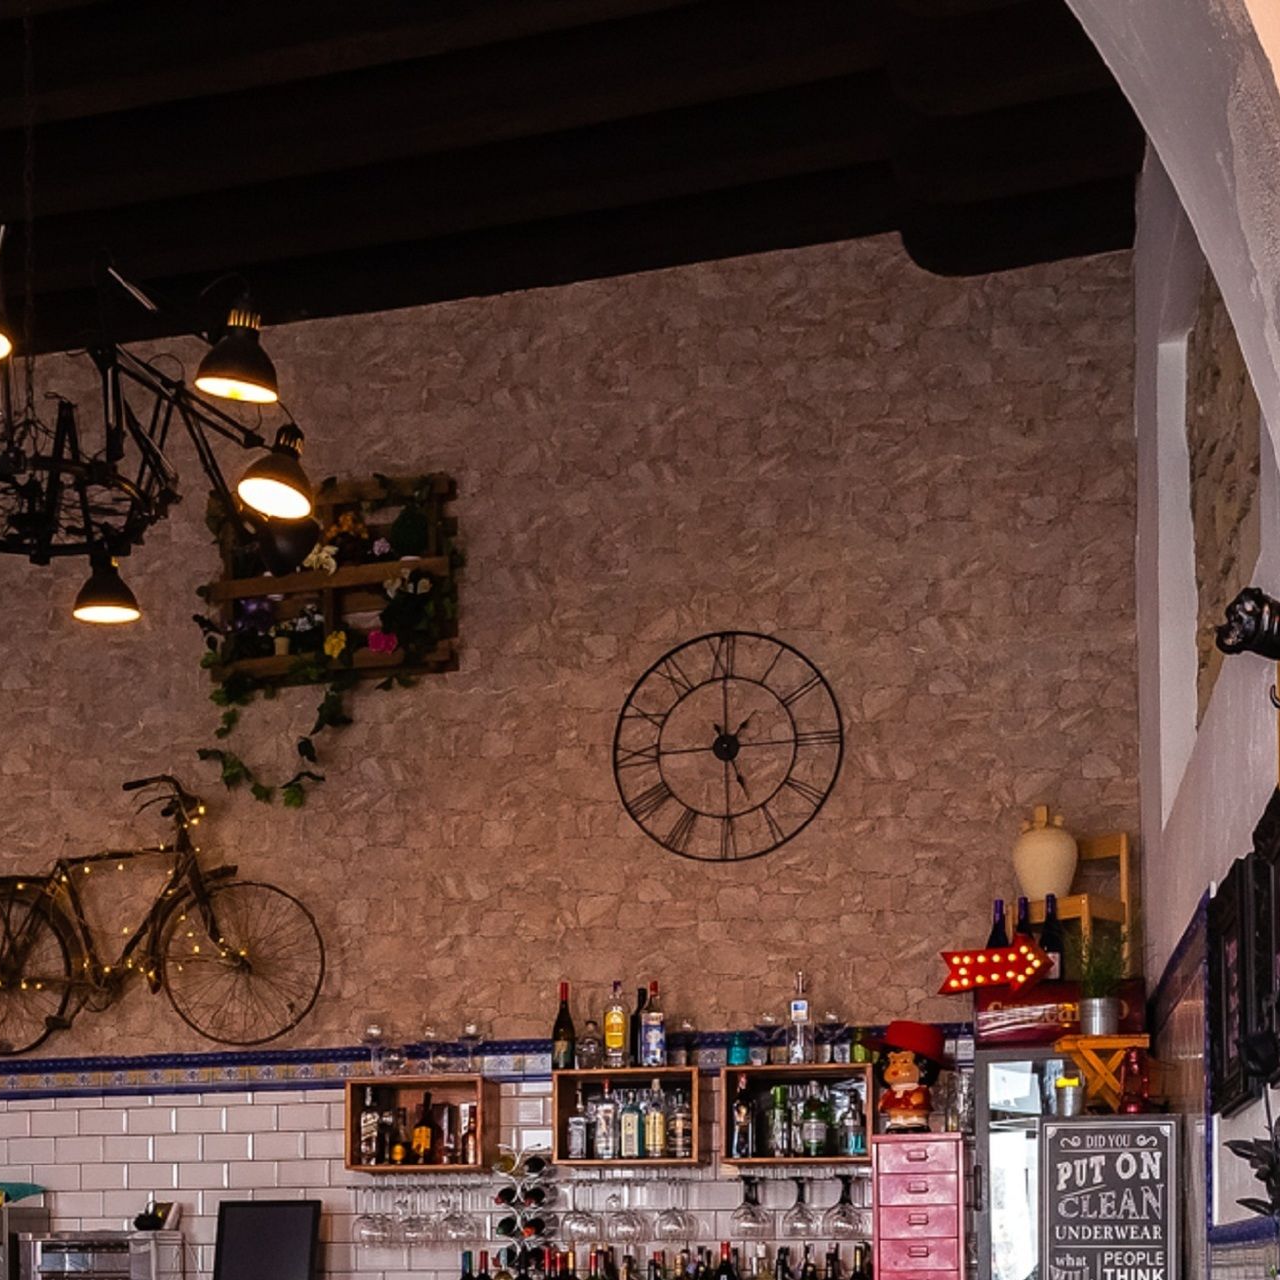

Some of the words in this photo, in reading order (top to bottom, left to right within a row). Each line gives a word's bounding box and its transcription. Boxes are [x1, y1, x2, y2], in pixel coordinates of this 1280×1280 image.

[1086, 1135, 1105, 1147] DID
[1107, 1134, 1131, 1147] YOU
[1056, 1155, 1106, 1191] PUT
[1115, 1151, 1162, 1180] ON
[1057, 1184, 1164, 1220] CLEAN
[1055, 1225, 1162, 1240] UNDERWEAR
[1055, 1254, 1087, 1267] what
[1104, 1251, 1165, 1266] PEOPLE
